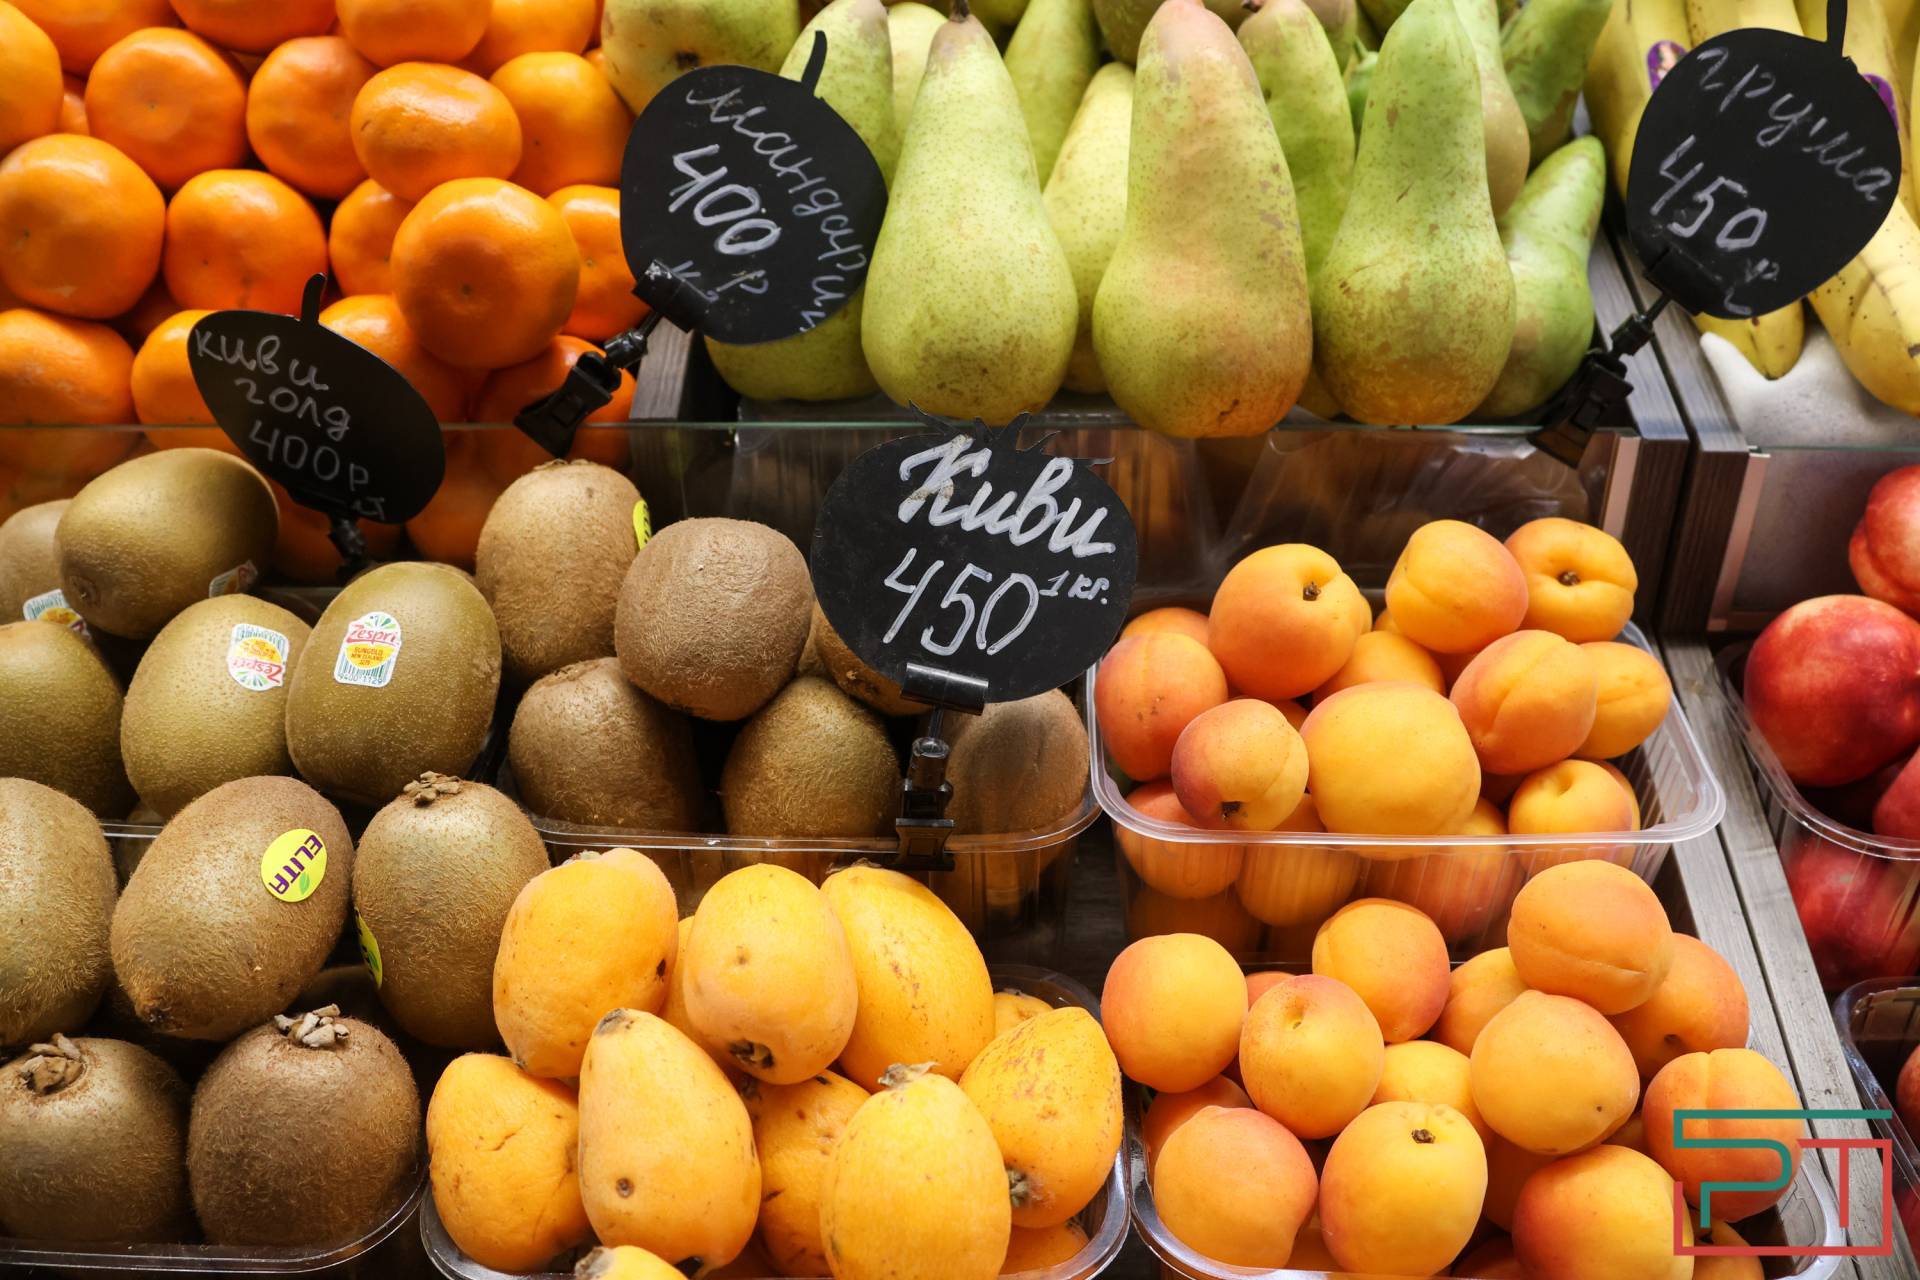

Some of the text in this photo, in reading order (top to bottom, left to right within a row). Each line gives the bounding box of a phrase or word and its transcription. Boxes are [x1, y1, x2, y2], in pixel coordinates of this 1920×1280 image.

[668, 144, 781, 255] 400
[1651, 134, 1768, 250] 450
[195, 328, 329, 390] киви
[234, 377, 351, 442] голд
[898, 433, 1116, 558] Киви
[883, 547, 1039, 656] 450
[269, 834, 323, 895] ELITA
